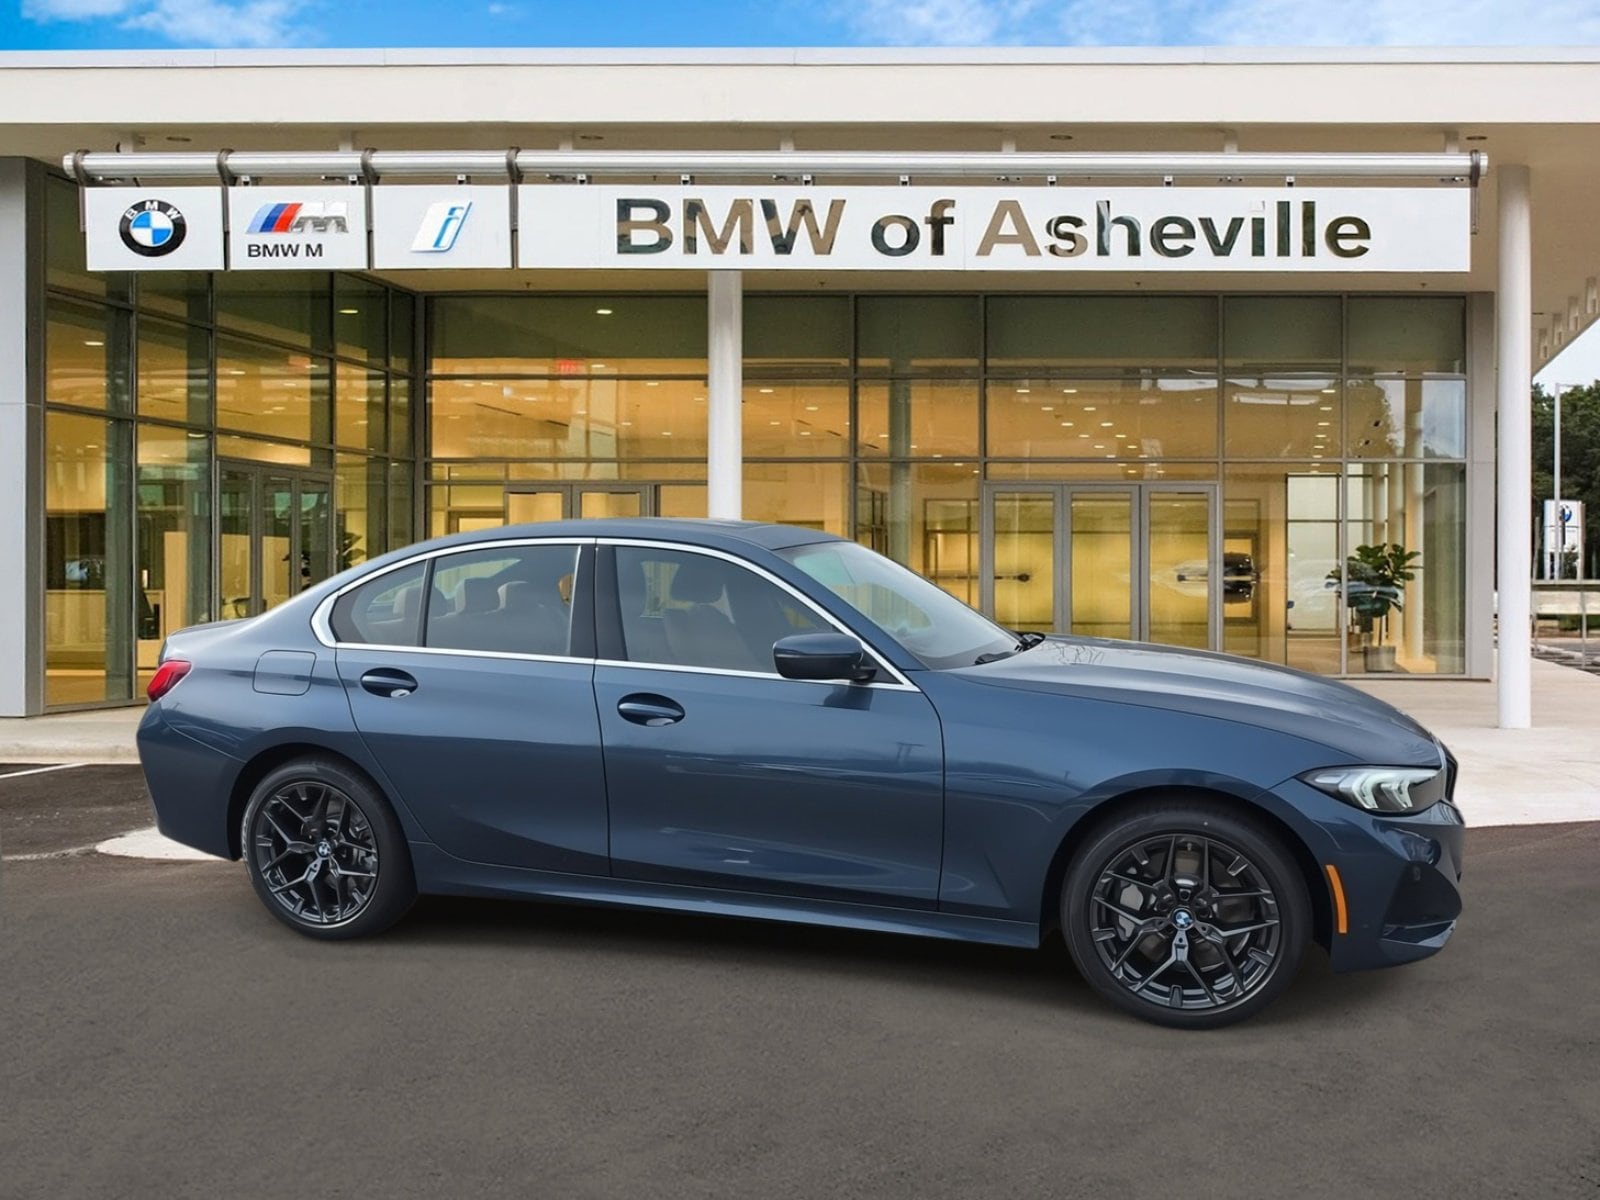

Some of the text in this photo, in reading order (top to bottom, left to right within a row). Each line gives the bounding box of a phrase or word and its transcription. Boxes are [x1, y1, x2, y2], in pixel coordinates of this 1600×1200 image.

[125, 201, 181, 220] BMW
[616, 198, 1372, 258] BMW of Asheville
[247, 243, 323, 257] BMW M
